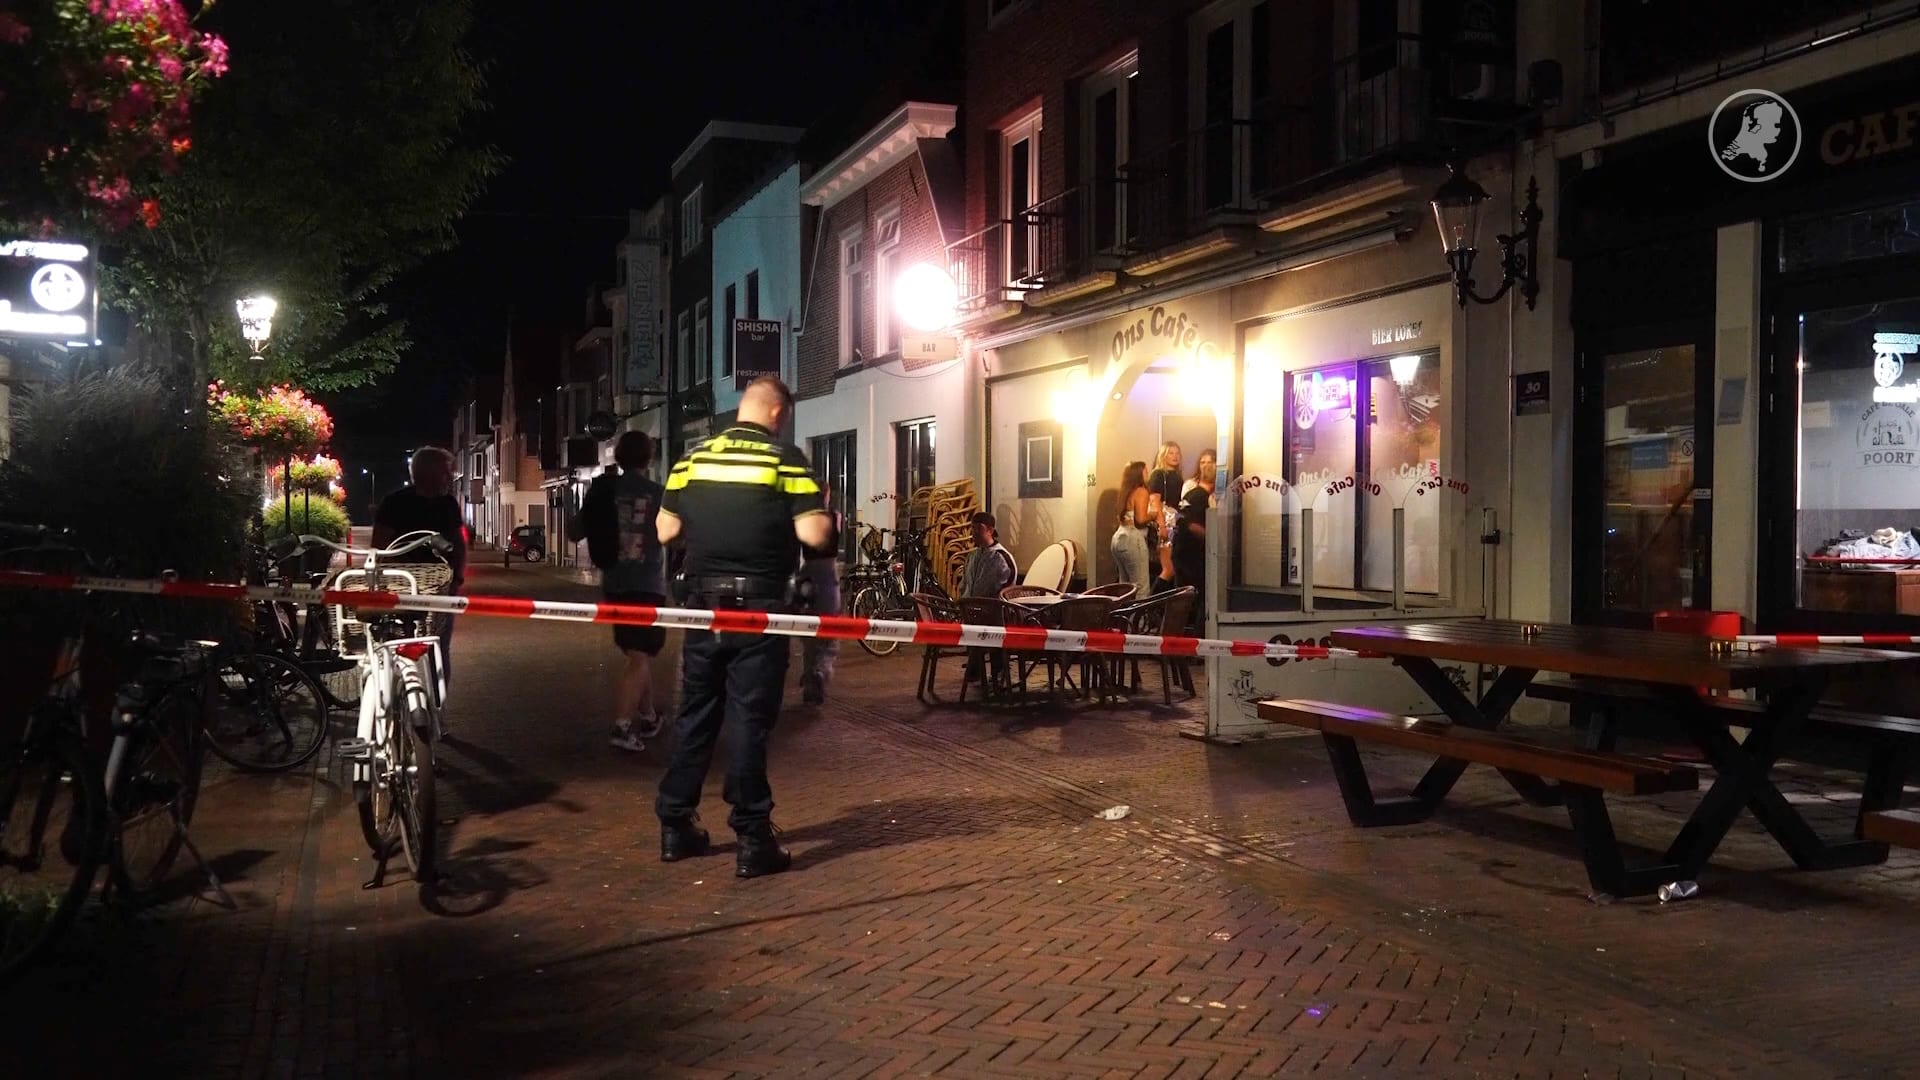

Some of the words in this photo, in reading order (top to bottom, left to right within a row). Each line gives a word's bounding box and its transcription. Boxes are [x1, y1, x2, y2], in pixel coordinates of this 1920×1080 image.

[736, 321, 779, 334] SHISHA
[751, 333, 765, 342] bar
[1112, 319, 1144, 362] Ons
[1371, 327, 1393, 346] BIER
[922, 343, 936, 353] BAR
[736, 369, 779, 378] restaurant
[1525, 381, 1541, 394] 30
[1863, 451, 1914, 465] POORT
